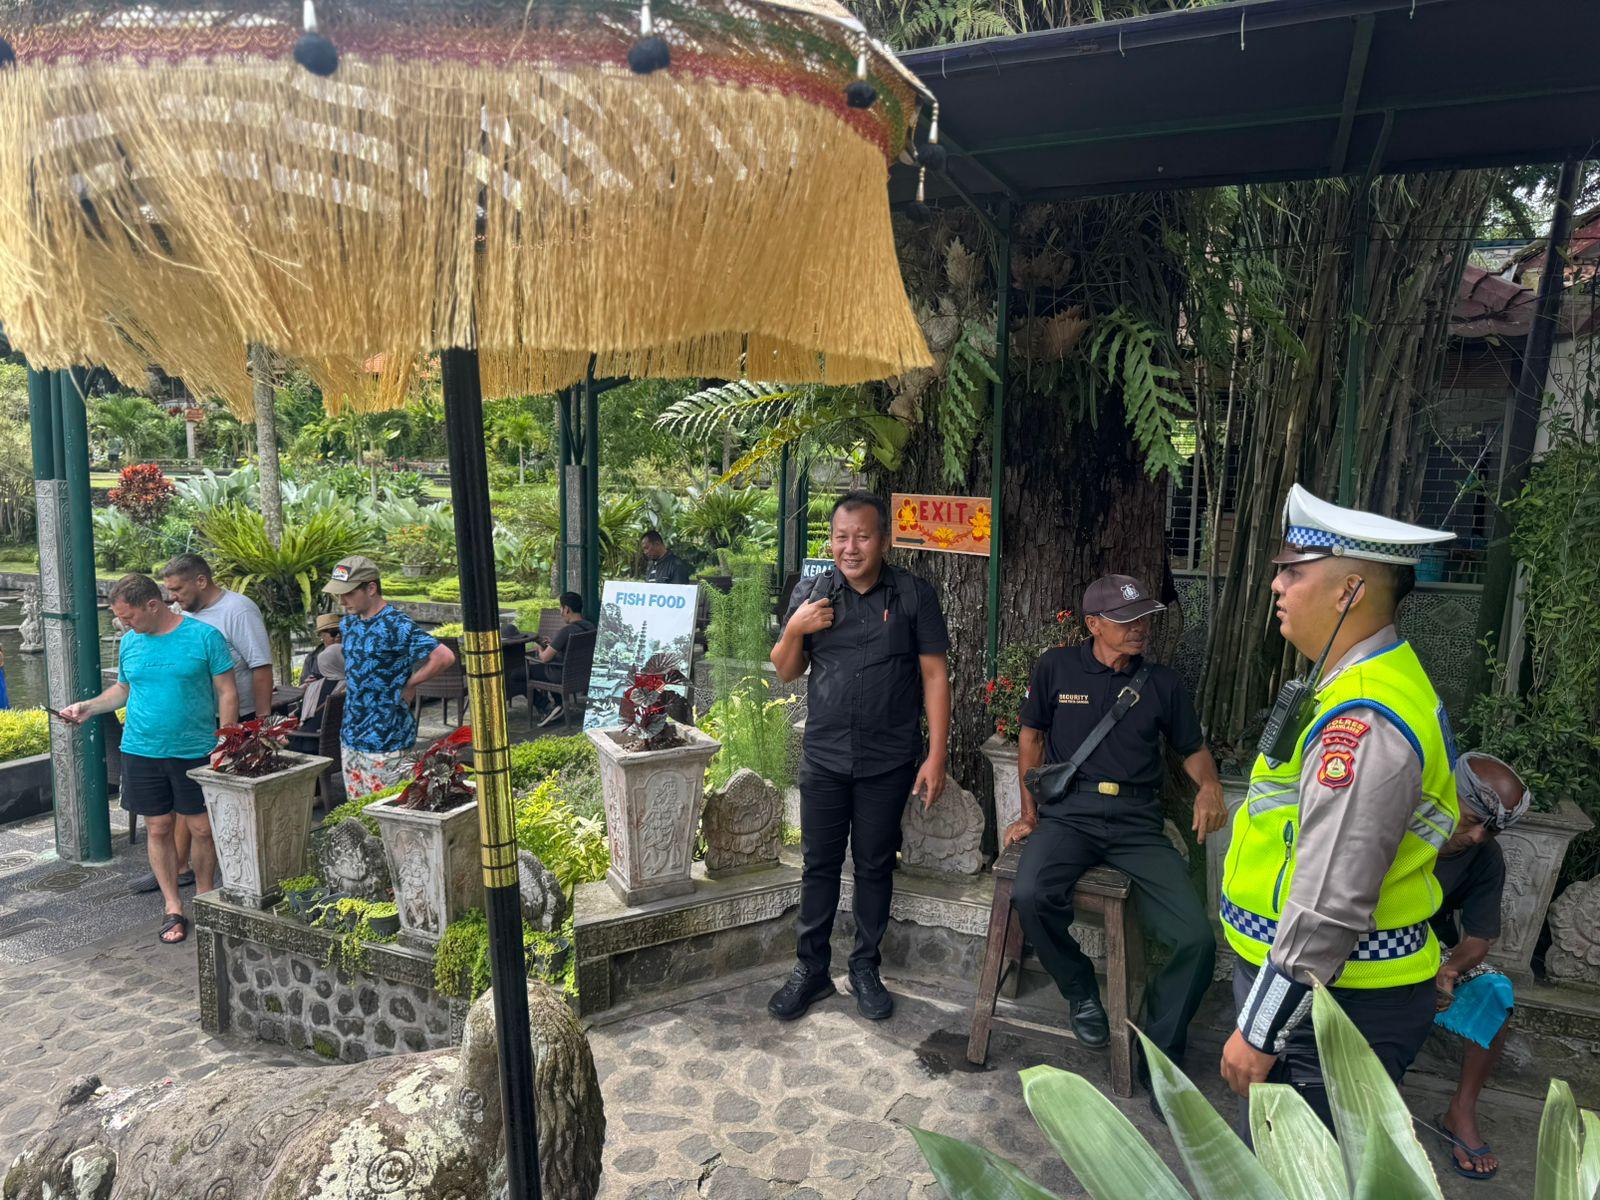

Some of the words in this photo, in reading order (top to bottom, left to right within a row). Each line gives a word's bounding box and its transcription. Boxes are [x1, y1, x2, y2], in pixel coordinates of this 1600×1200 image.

[919, 500, 968, 524] EXIT
[615, 591, 646, 606] FISH
[648, 594, 686, 609] FOOD
